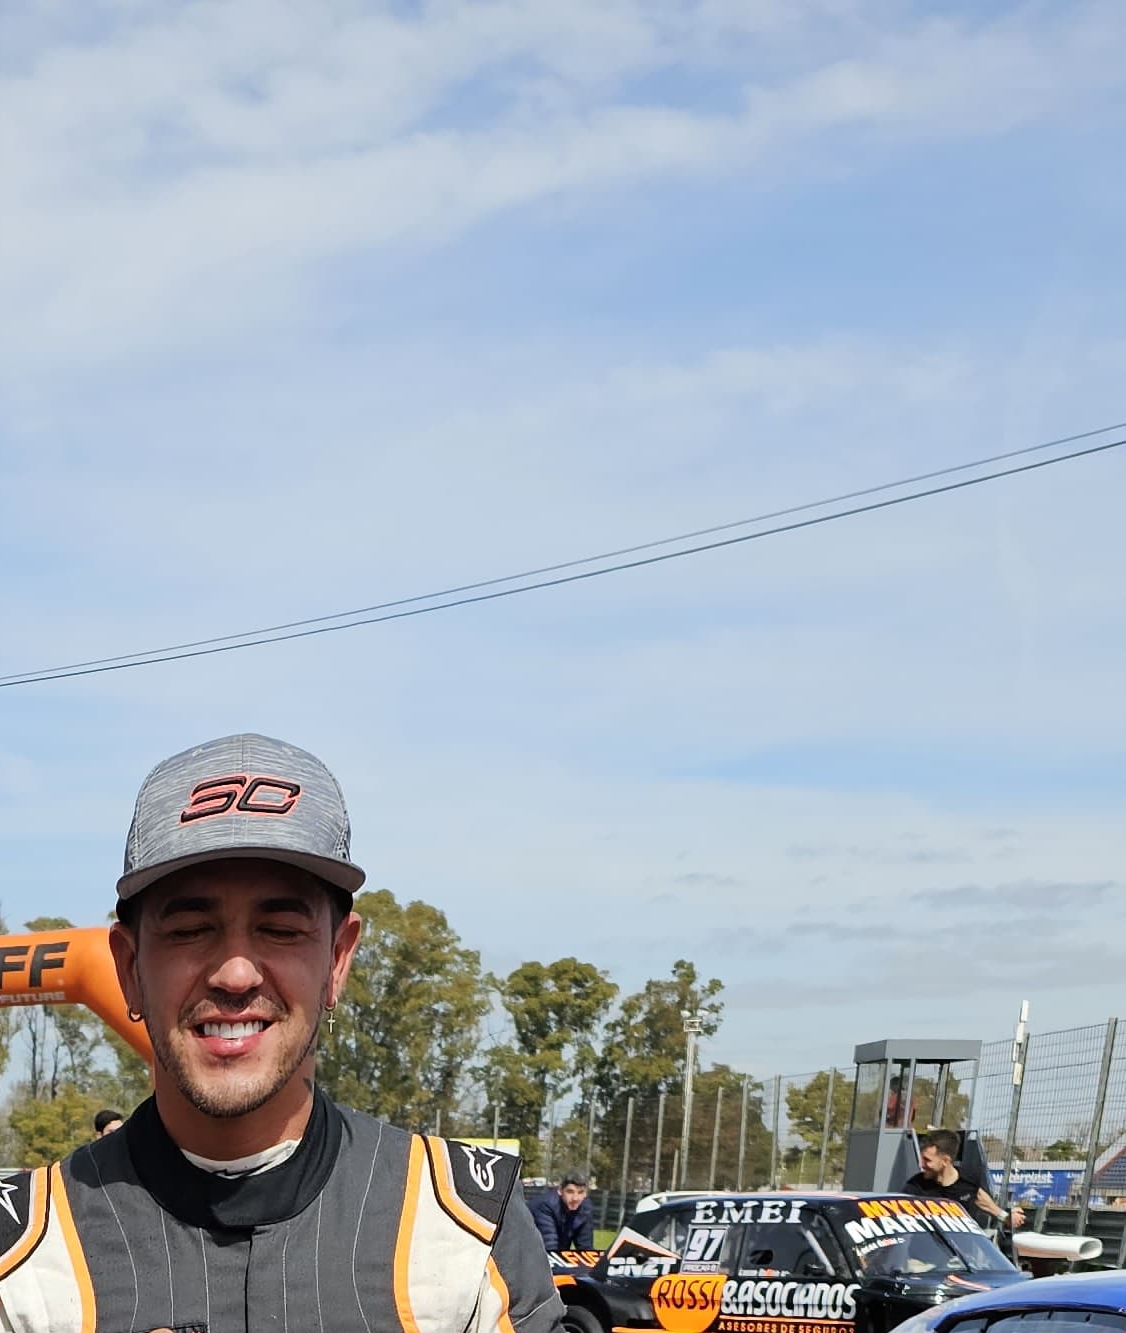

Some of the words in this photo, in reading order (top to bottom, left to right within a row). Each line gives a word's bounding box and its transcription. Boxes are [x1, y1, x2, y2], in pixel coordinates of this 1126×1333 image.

[180, 775, 301, 823] SC
[691, 1200, 808, 1224] EMEI
[686, 1229, 724, 1262] 97
[657, 1279, 719, 1311] ROSSI
